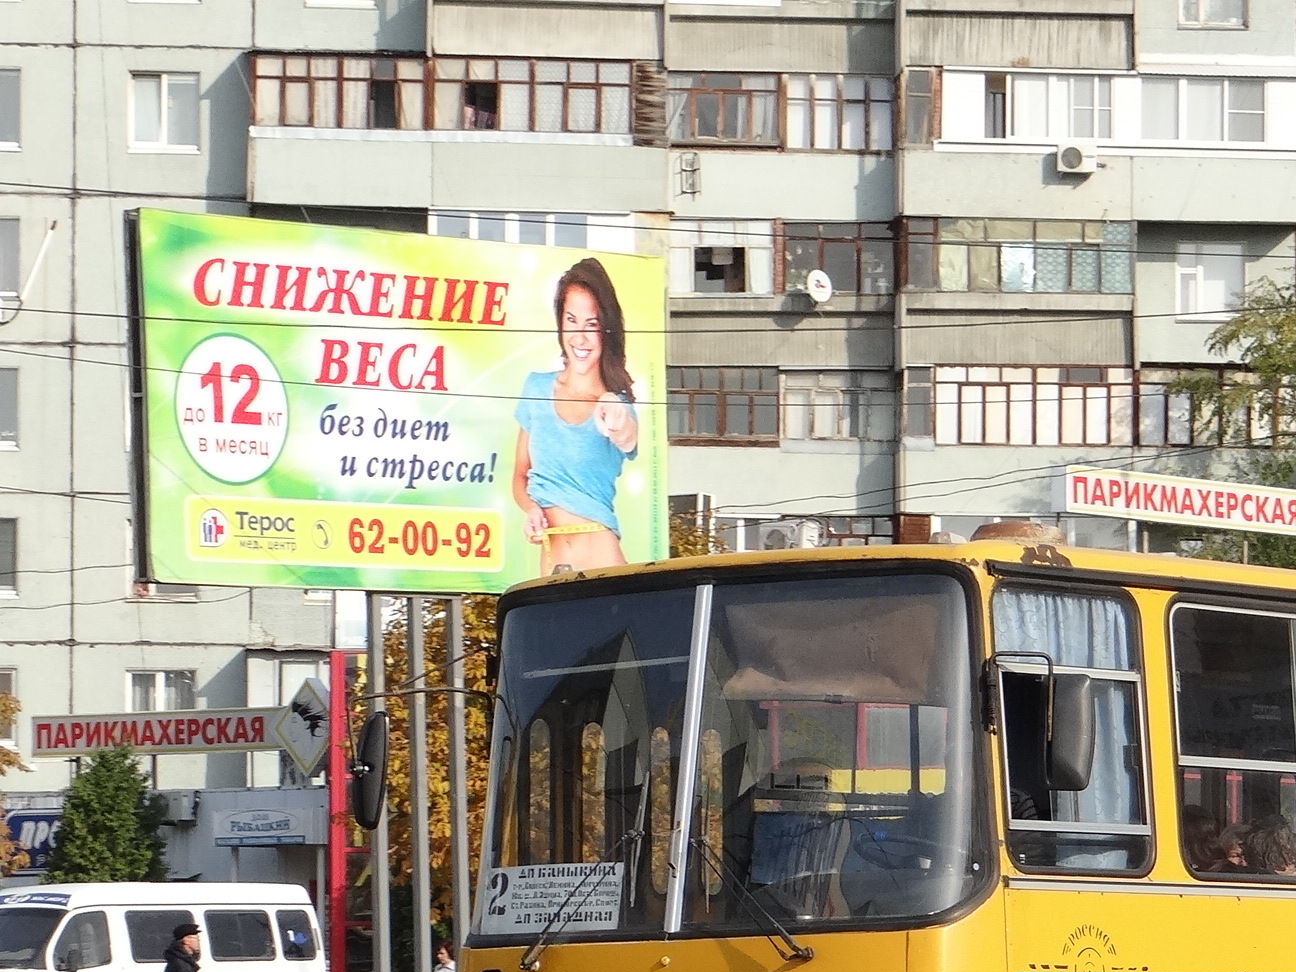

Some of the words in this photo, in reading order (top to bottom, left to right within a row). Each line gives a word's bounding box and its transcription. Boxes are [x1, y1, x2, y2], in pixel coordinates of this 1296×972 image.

[193, 257, 509, 326] СНИЖЕНИЕ
[314, 338, 448, 391] ВЕСА
[183, 407, 205, 425] до
[200, 361, 262, 425] 12
[267, 412, 283, 426] кг
[319, 402, 364, 437] без
[373, 406, 450, 442] диет
[198, 437, 208, 452] в
[215, 438, 270, 459] месяц
[339, 456, 359, 478] и
[366, 452, 498, 490] стресса!
[235, 511, 296, 534] Терос
[348, 517, 492, 558] 62-00-92
[267, 541, 297, 551] центр
[36, 716, 265, 750] ПАРИКМАХЕРСКАЯ
[488, 872, 509, 915] 2
